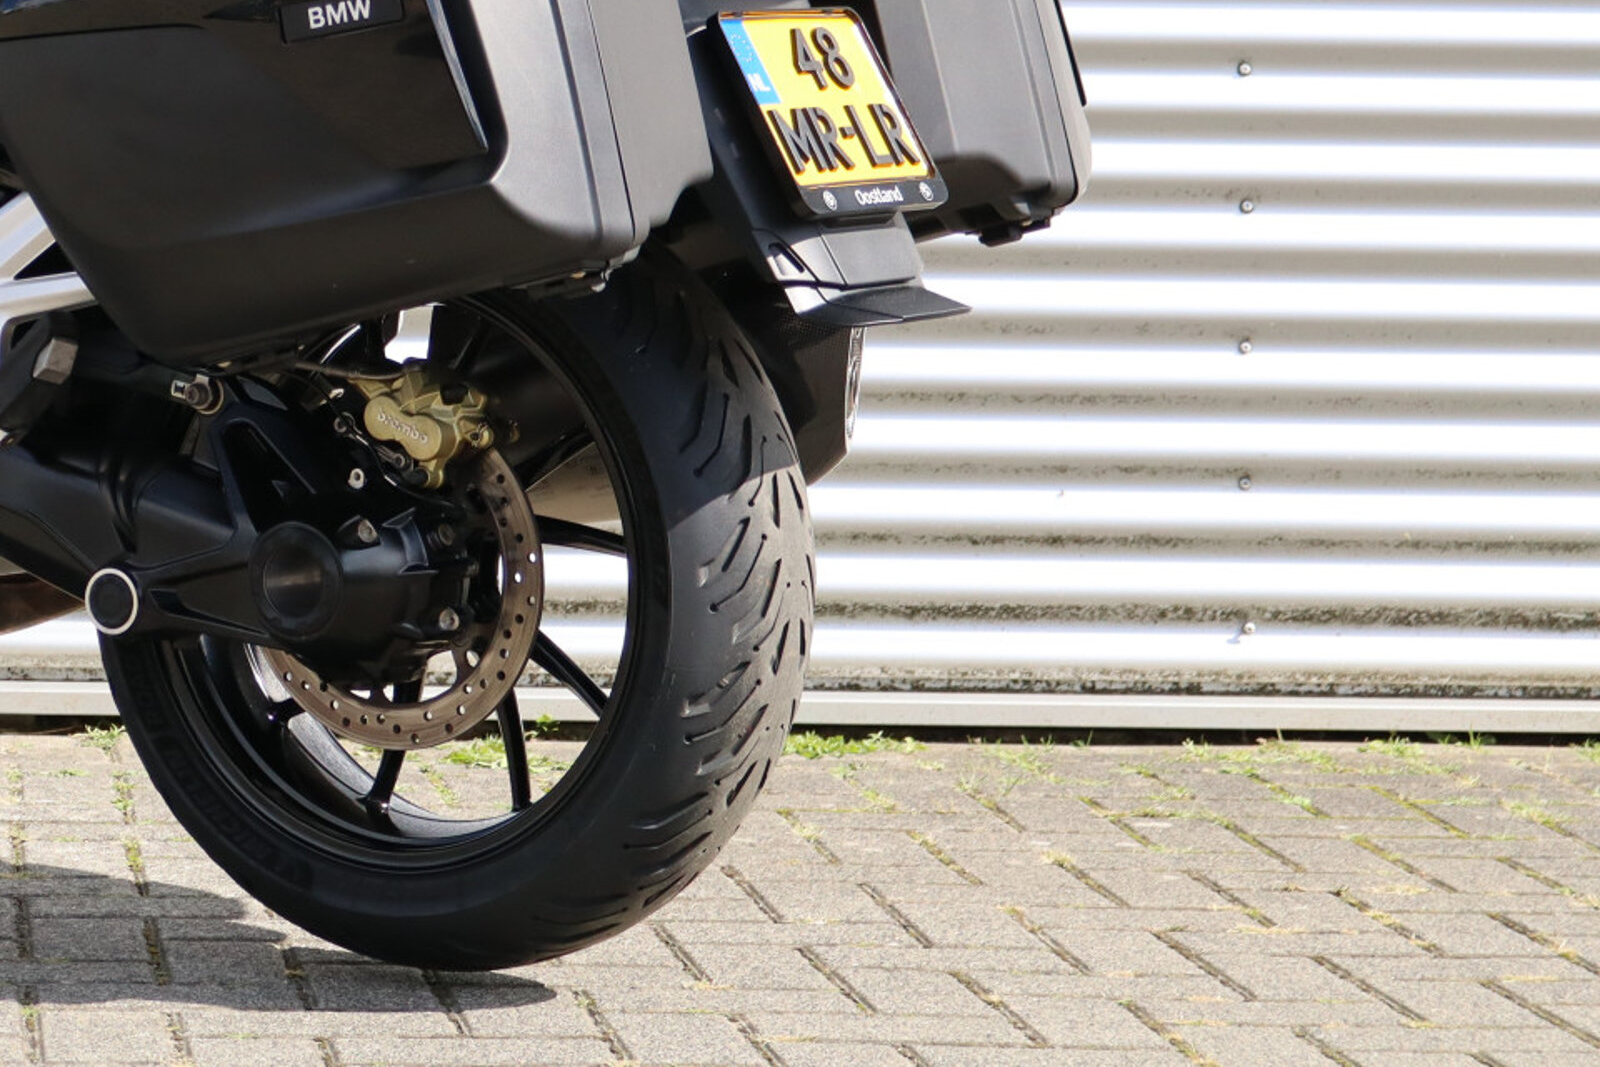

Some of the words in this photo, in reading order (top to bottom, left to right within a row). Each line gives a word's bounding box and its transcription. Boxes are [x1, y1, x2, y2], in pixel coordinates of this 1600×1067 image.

[790, 27, 855, 91] 48
[746, 73, 771, 92] NL
[766, 103, 921, 175] MR-LR
[854, 185, 904, 205] Oostland
[377, 406, 428, 444] brembo
